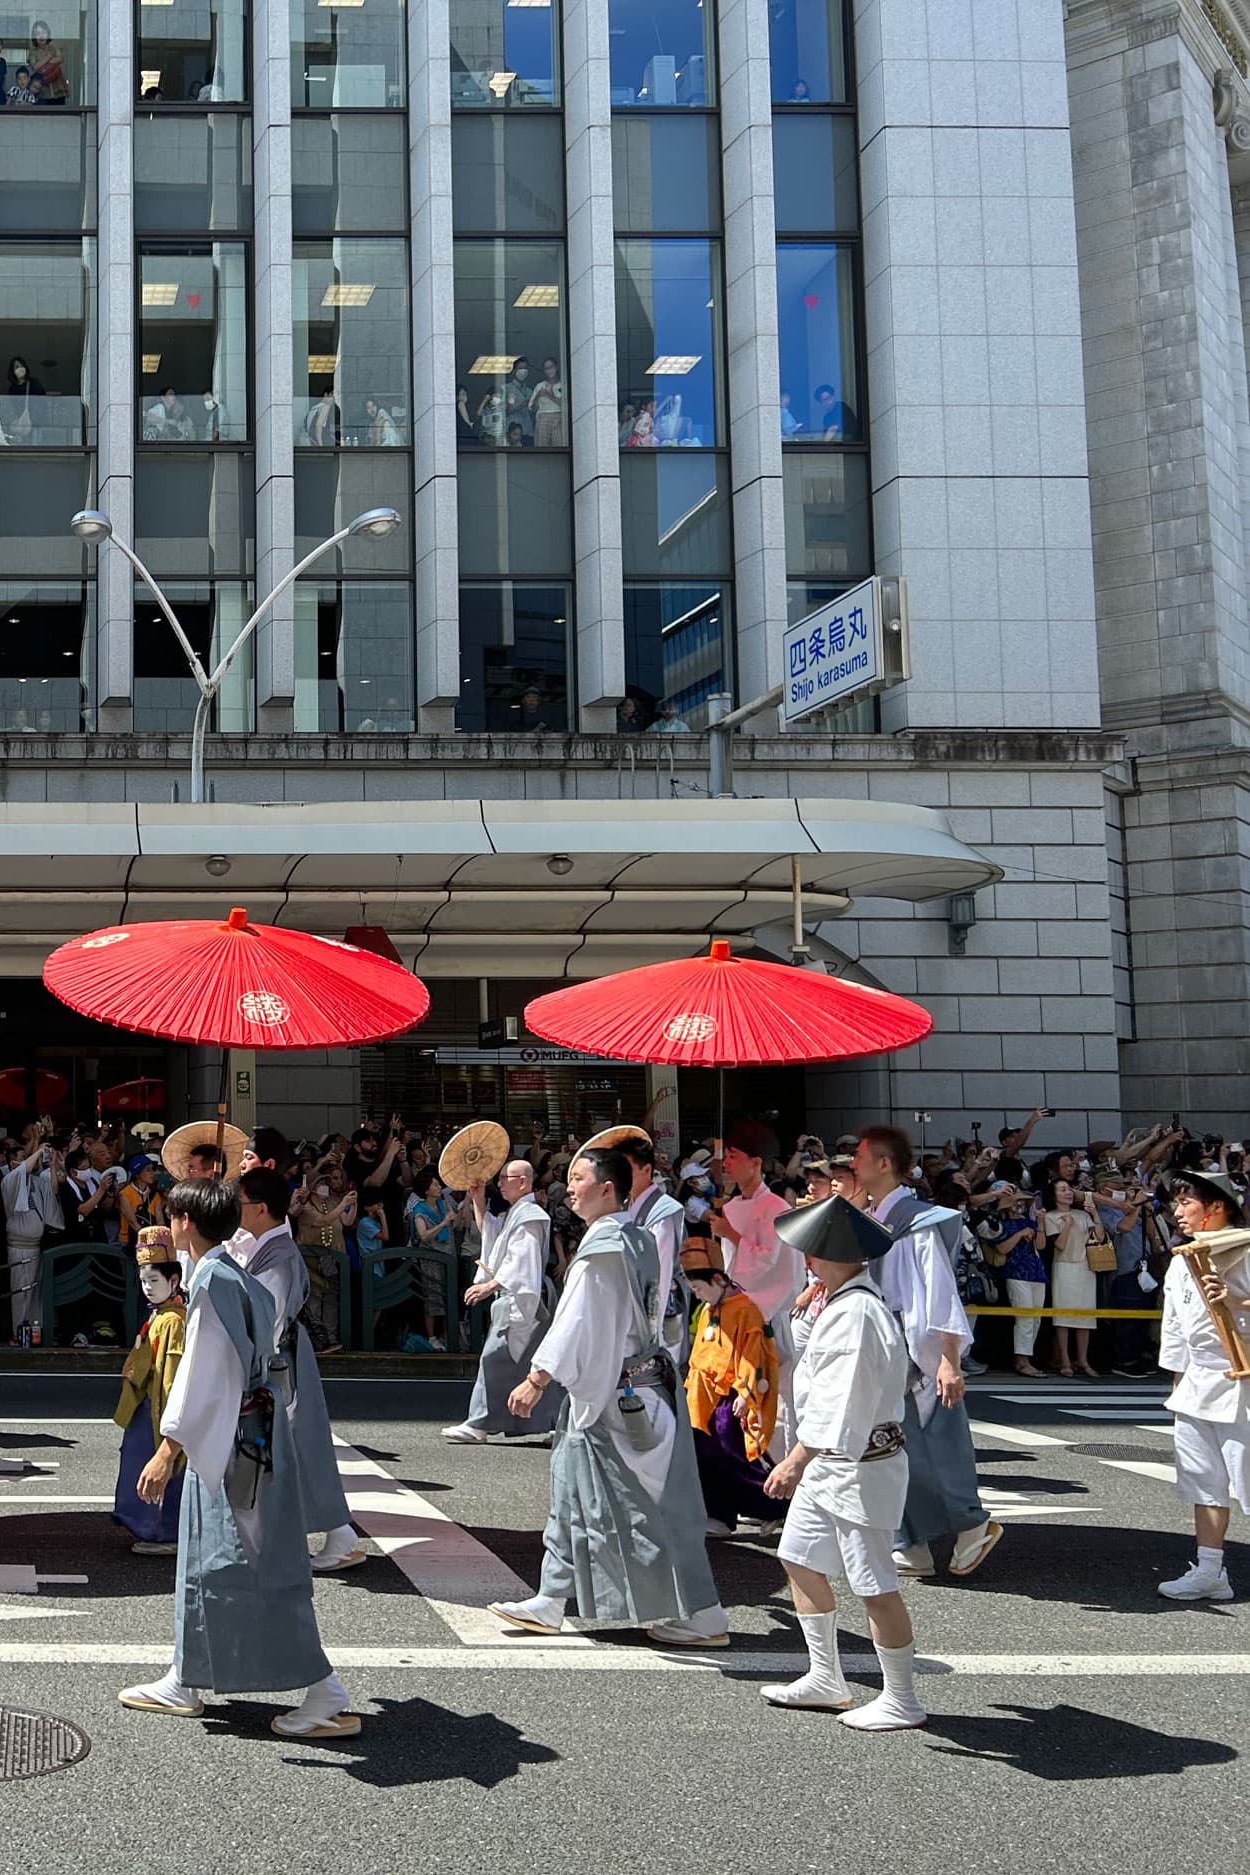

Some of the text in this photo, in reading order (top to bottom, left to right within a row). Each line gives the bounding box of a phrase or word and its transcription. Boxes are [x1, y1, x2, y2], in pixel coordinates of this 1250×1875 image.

[790, 606, 867, 678] 四条烏丸
[791, 651, 868, 703] Shijo karasuma
[542, 1050, 579, 1060] MUFG
